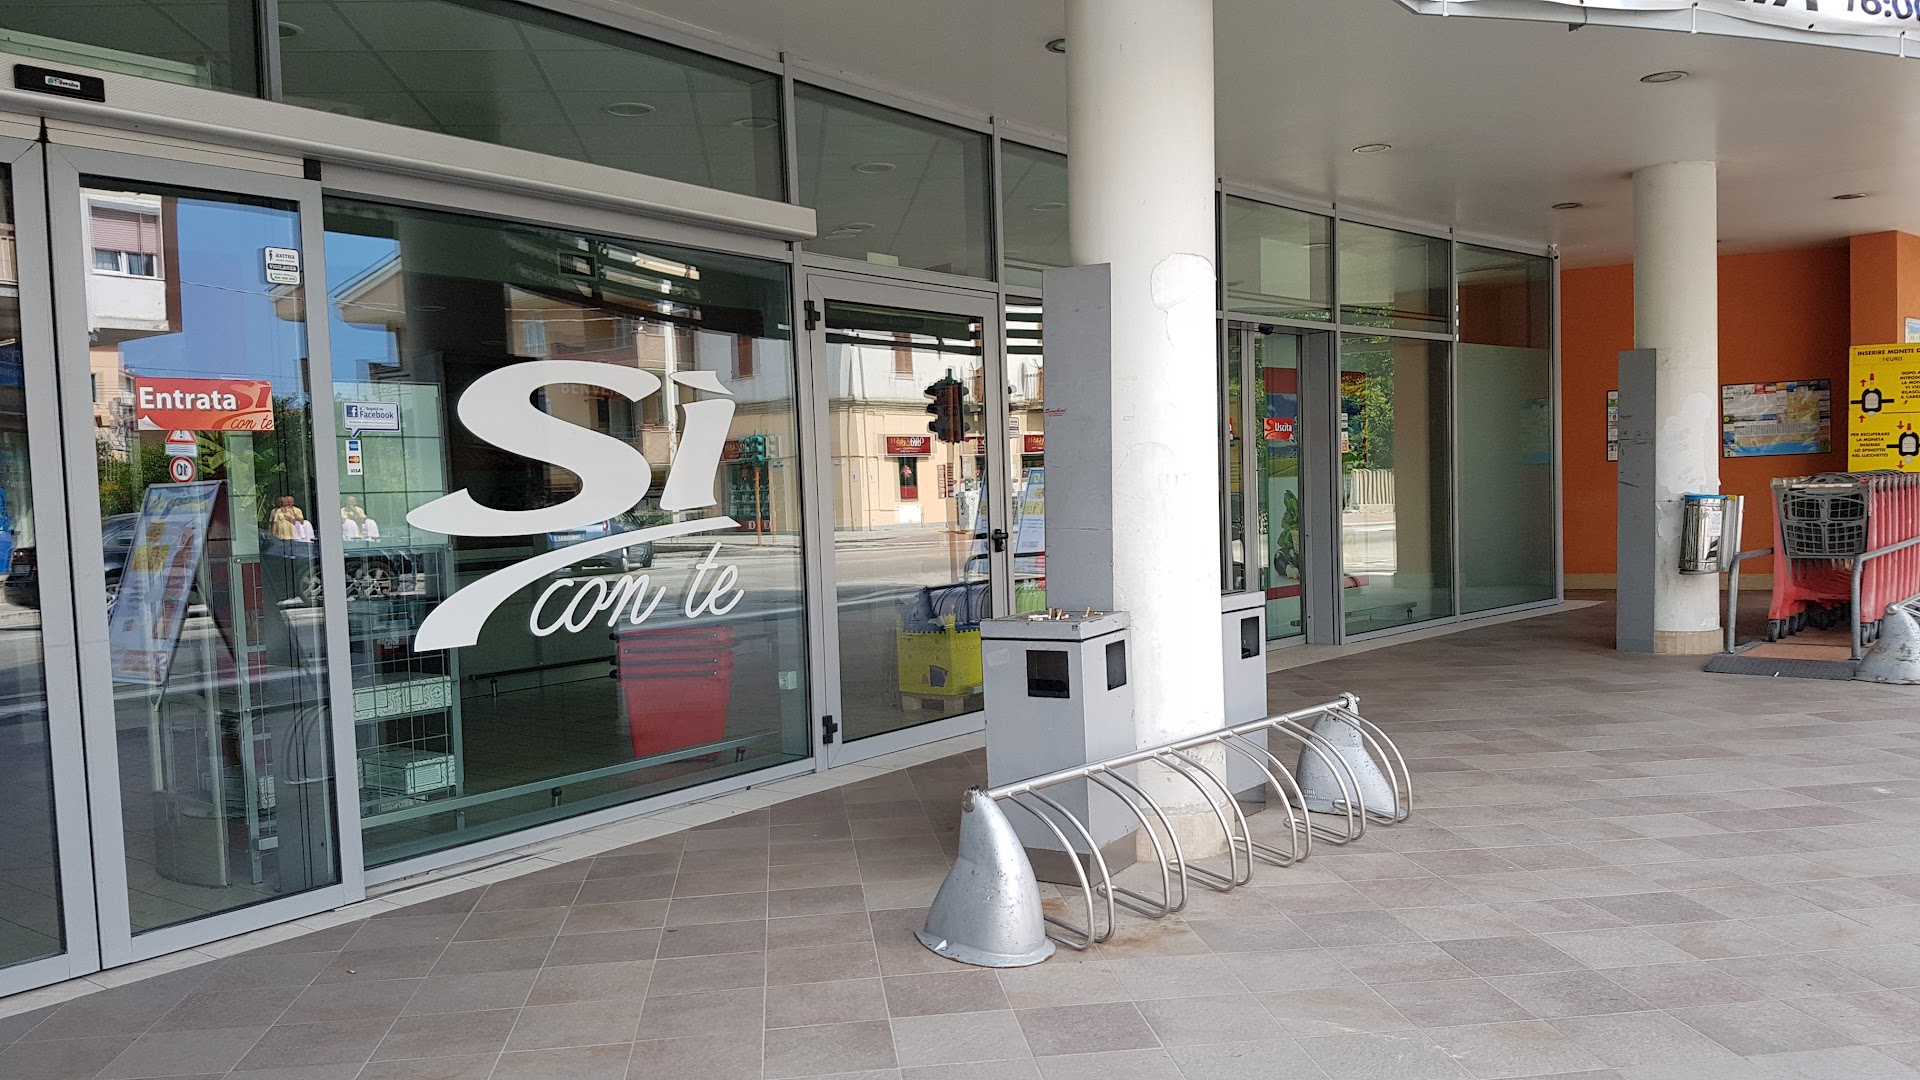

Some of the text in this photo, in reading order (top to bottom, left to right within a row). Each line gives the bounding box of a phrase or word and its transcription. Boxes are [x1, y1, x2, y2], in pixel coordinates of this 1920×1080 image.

[139, 386, 238, 410] Entrata
[230, 414, 274, 430] con te
[360, 411, 394, 419] Facebook
[1275, 422, 1293, 432] Uscita
[530, 541, 745, 637] con te
